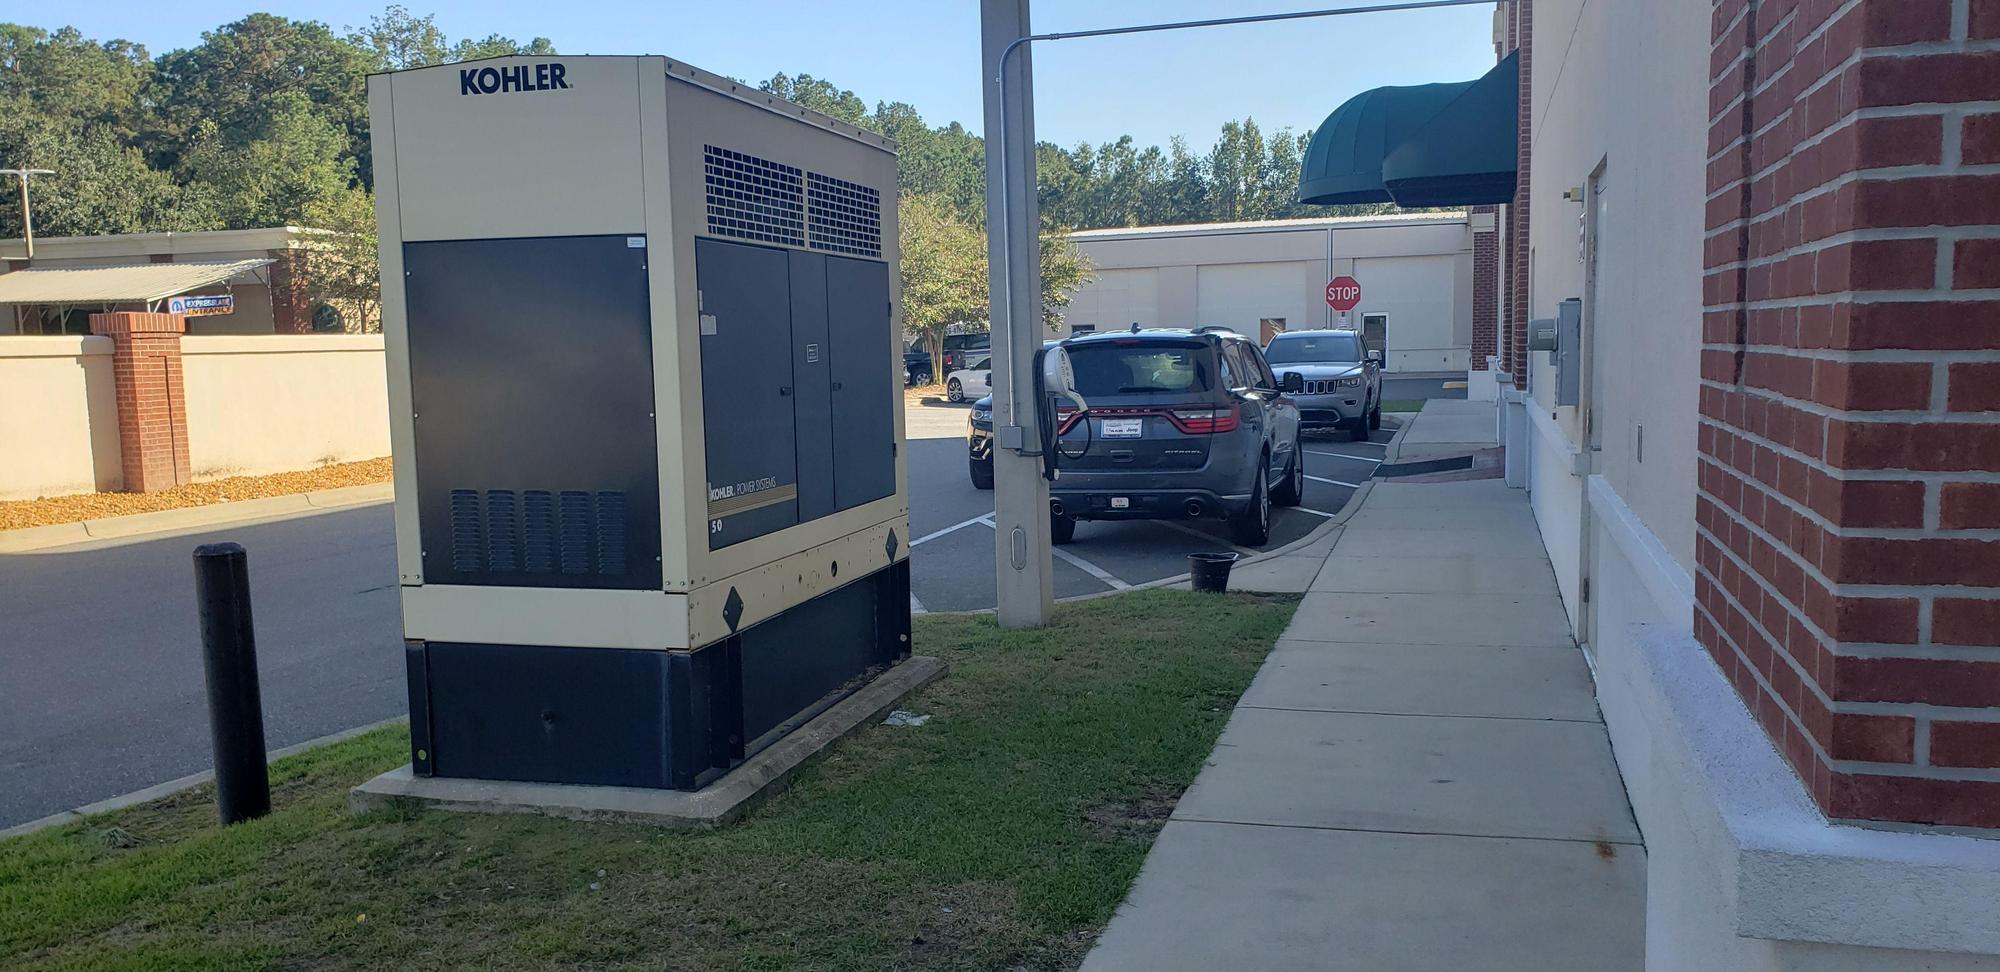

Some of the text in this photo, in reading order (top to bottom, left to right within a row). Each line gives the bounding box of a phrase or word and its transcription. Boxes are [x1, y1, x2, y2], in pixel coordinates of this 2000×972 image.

[460, 63, 569, 95] KOHLER
[1327, 286, 1360, 301] STOP
[711, 476, 777, 500] KOHLER POWER SYSTEMS
[711, 519, 723, 533] 50
